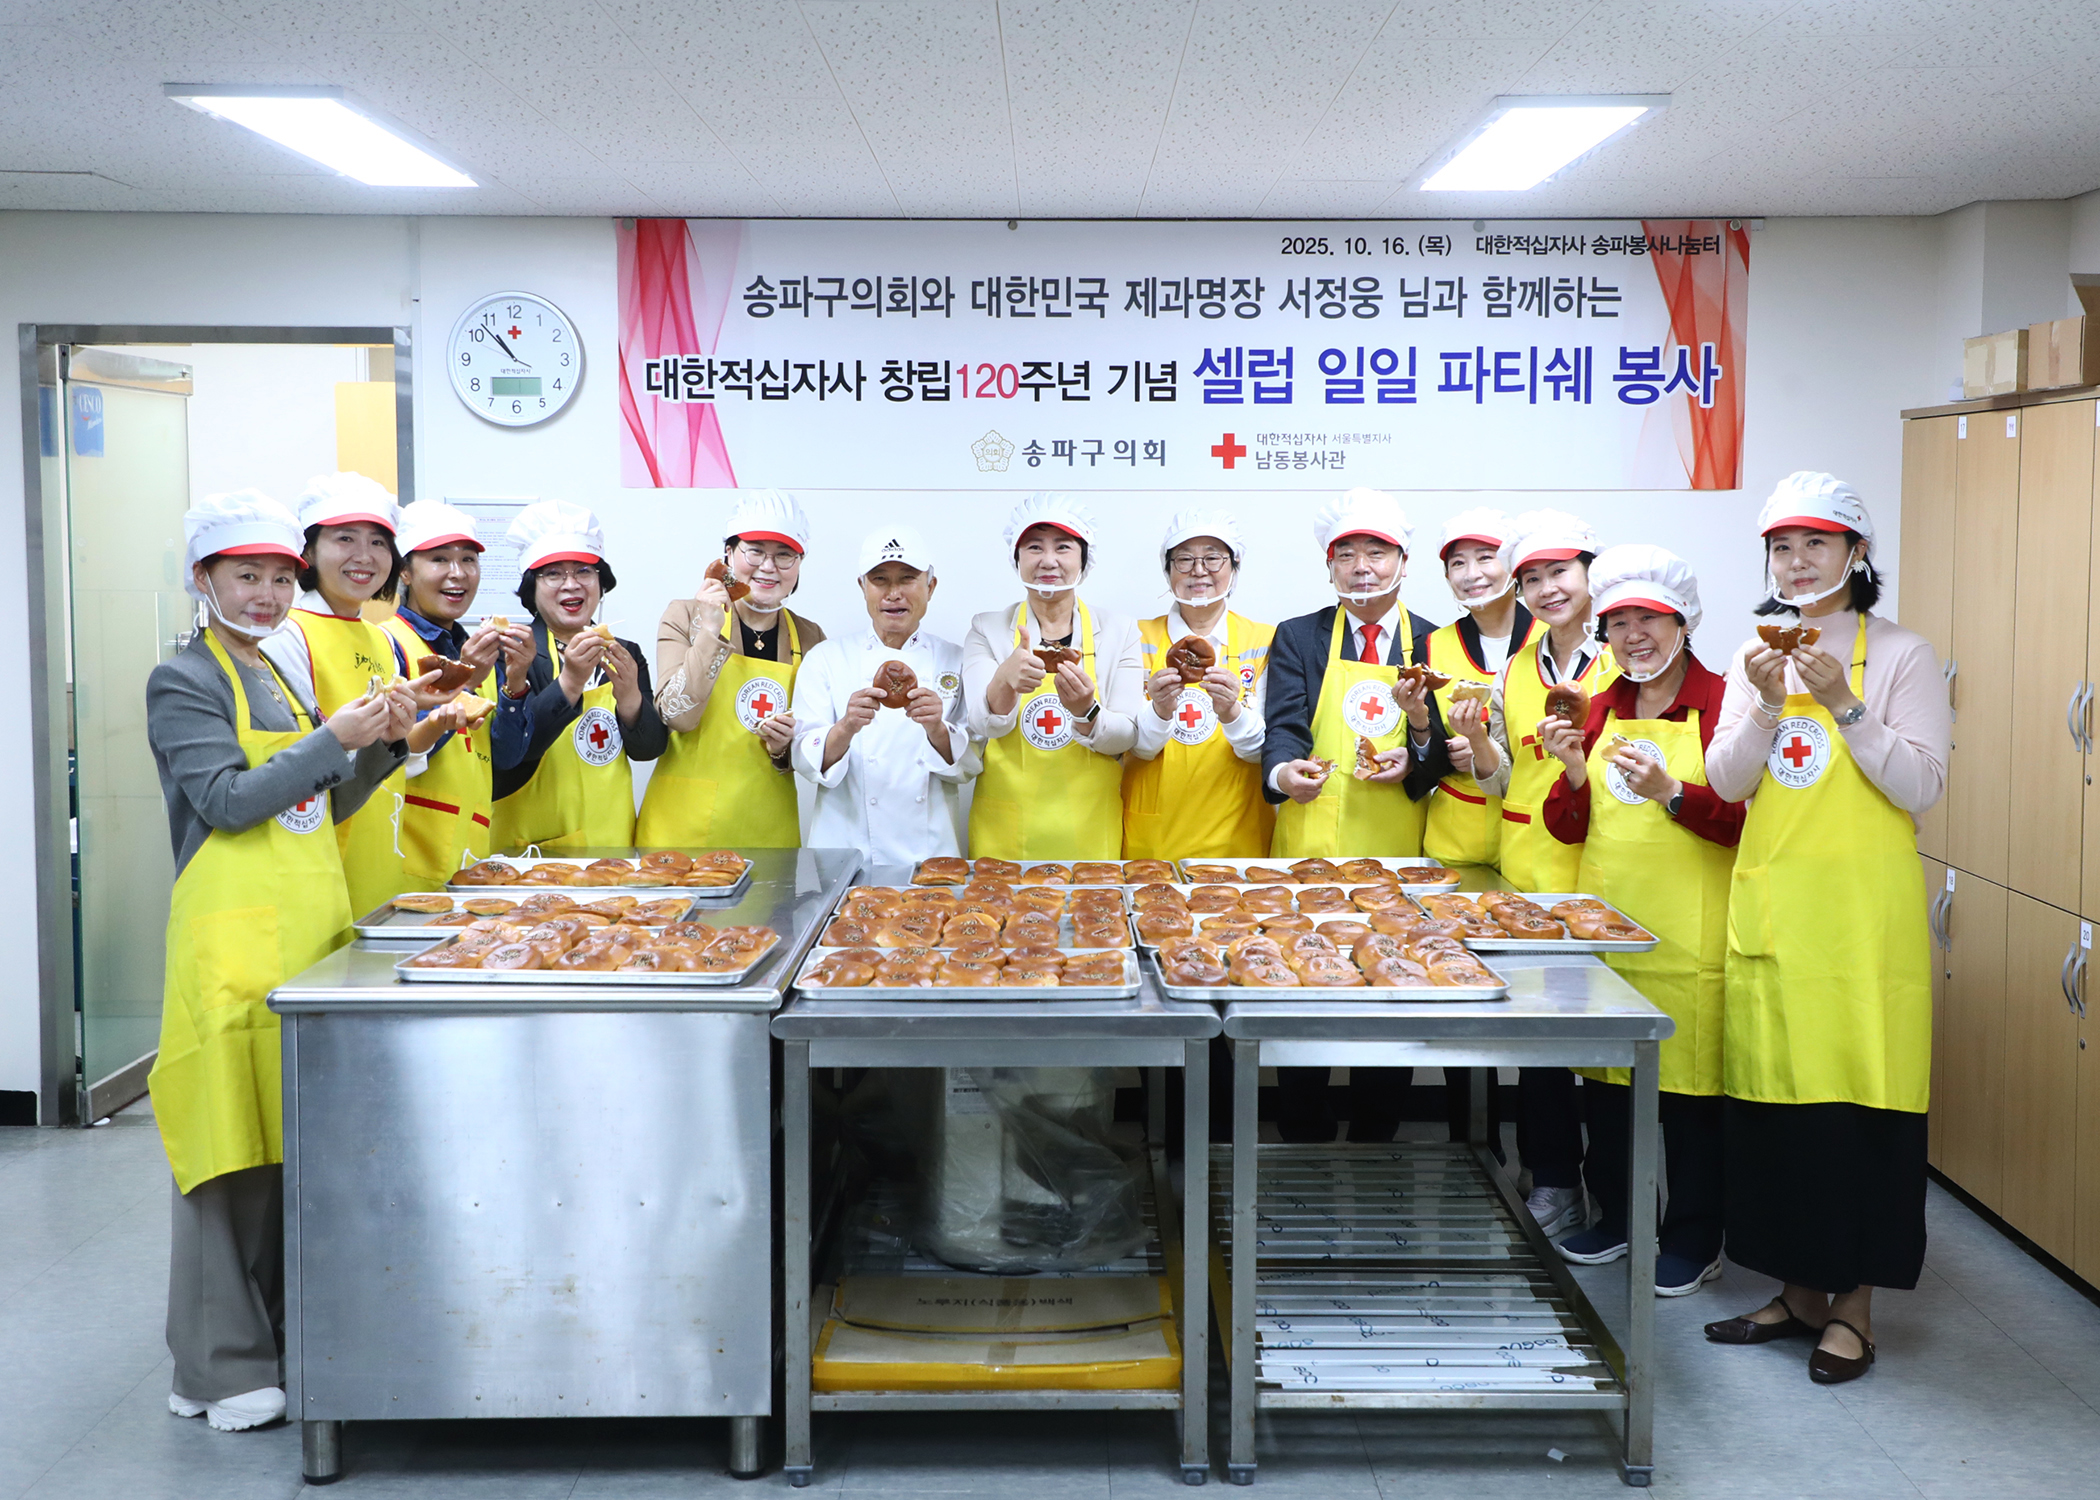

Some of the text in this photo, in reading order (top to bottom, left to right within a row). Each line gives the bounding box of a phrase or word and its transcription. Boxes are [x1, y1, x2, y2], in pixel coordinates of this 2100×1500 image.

[1281, 235, 1721, 257] 2025. 10. 16. (목) 대한적십자사 송파봉사나눔터
[742, 275, 1622, 319] 송파구의회와 대한민국 제과명장 서정웅 님과 함께하는
[506, 304, 522, 319] 12
[483, 312, 496, 327] 11
[536, 314, 542, 327] 1
[468, 328, 485, 343] 10
[552, 328, 562, 343] 2
[461, 352, 471, 367] 9
[560, 352, 570, 367] 3
[646, 345, 1720, 407] 대한적십자사 창립120주년 기념 셀럽 일일 파티쉐 봉사
[470, 377, 481, 392] 8
[552, 377, 562, 391] 4
[488, 397, 495, 408] 7
[512, 399, 522, 414] 6
[539, 397, 546, 408] 5
[1256, 432, 1392, 446] 대한적십자사 서울특별지사
[1022, 438, 1167, 468] 송파구의회
[1255, 450, 1346, 470] 남동봉사관
[741, 681, 784, 709] KOREAN RED CROSS
[1349, 685, 1372, 704] KOREAN
[1373, 684, 1387, 694] RED
[1185, 691, 1197, 700] RED
[1196, 694, 1214, 714] CROSS
[1024, 700, 1044, 724] KOREAN
[1044, 697, 1058, 705] RED
[578, 710, 619, 741] KOREAN RED CROSS
[1030, 732, 1070, 748] 대한적십자사
[1790, 721, 1808, 730] RED
[1808, 725, 1826, 750] CROSS
[1777, 764, 1822, 785] 대한적십자사
[2083, 930, 2090, 941] 20
